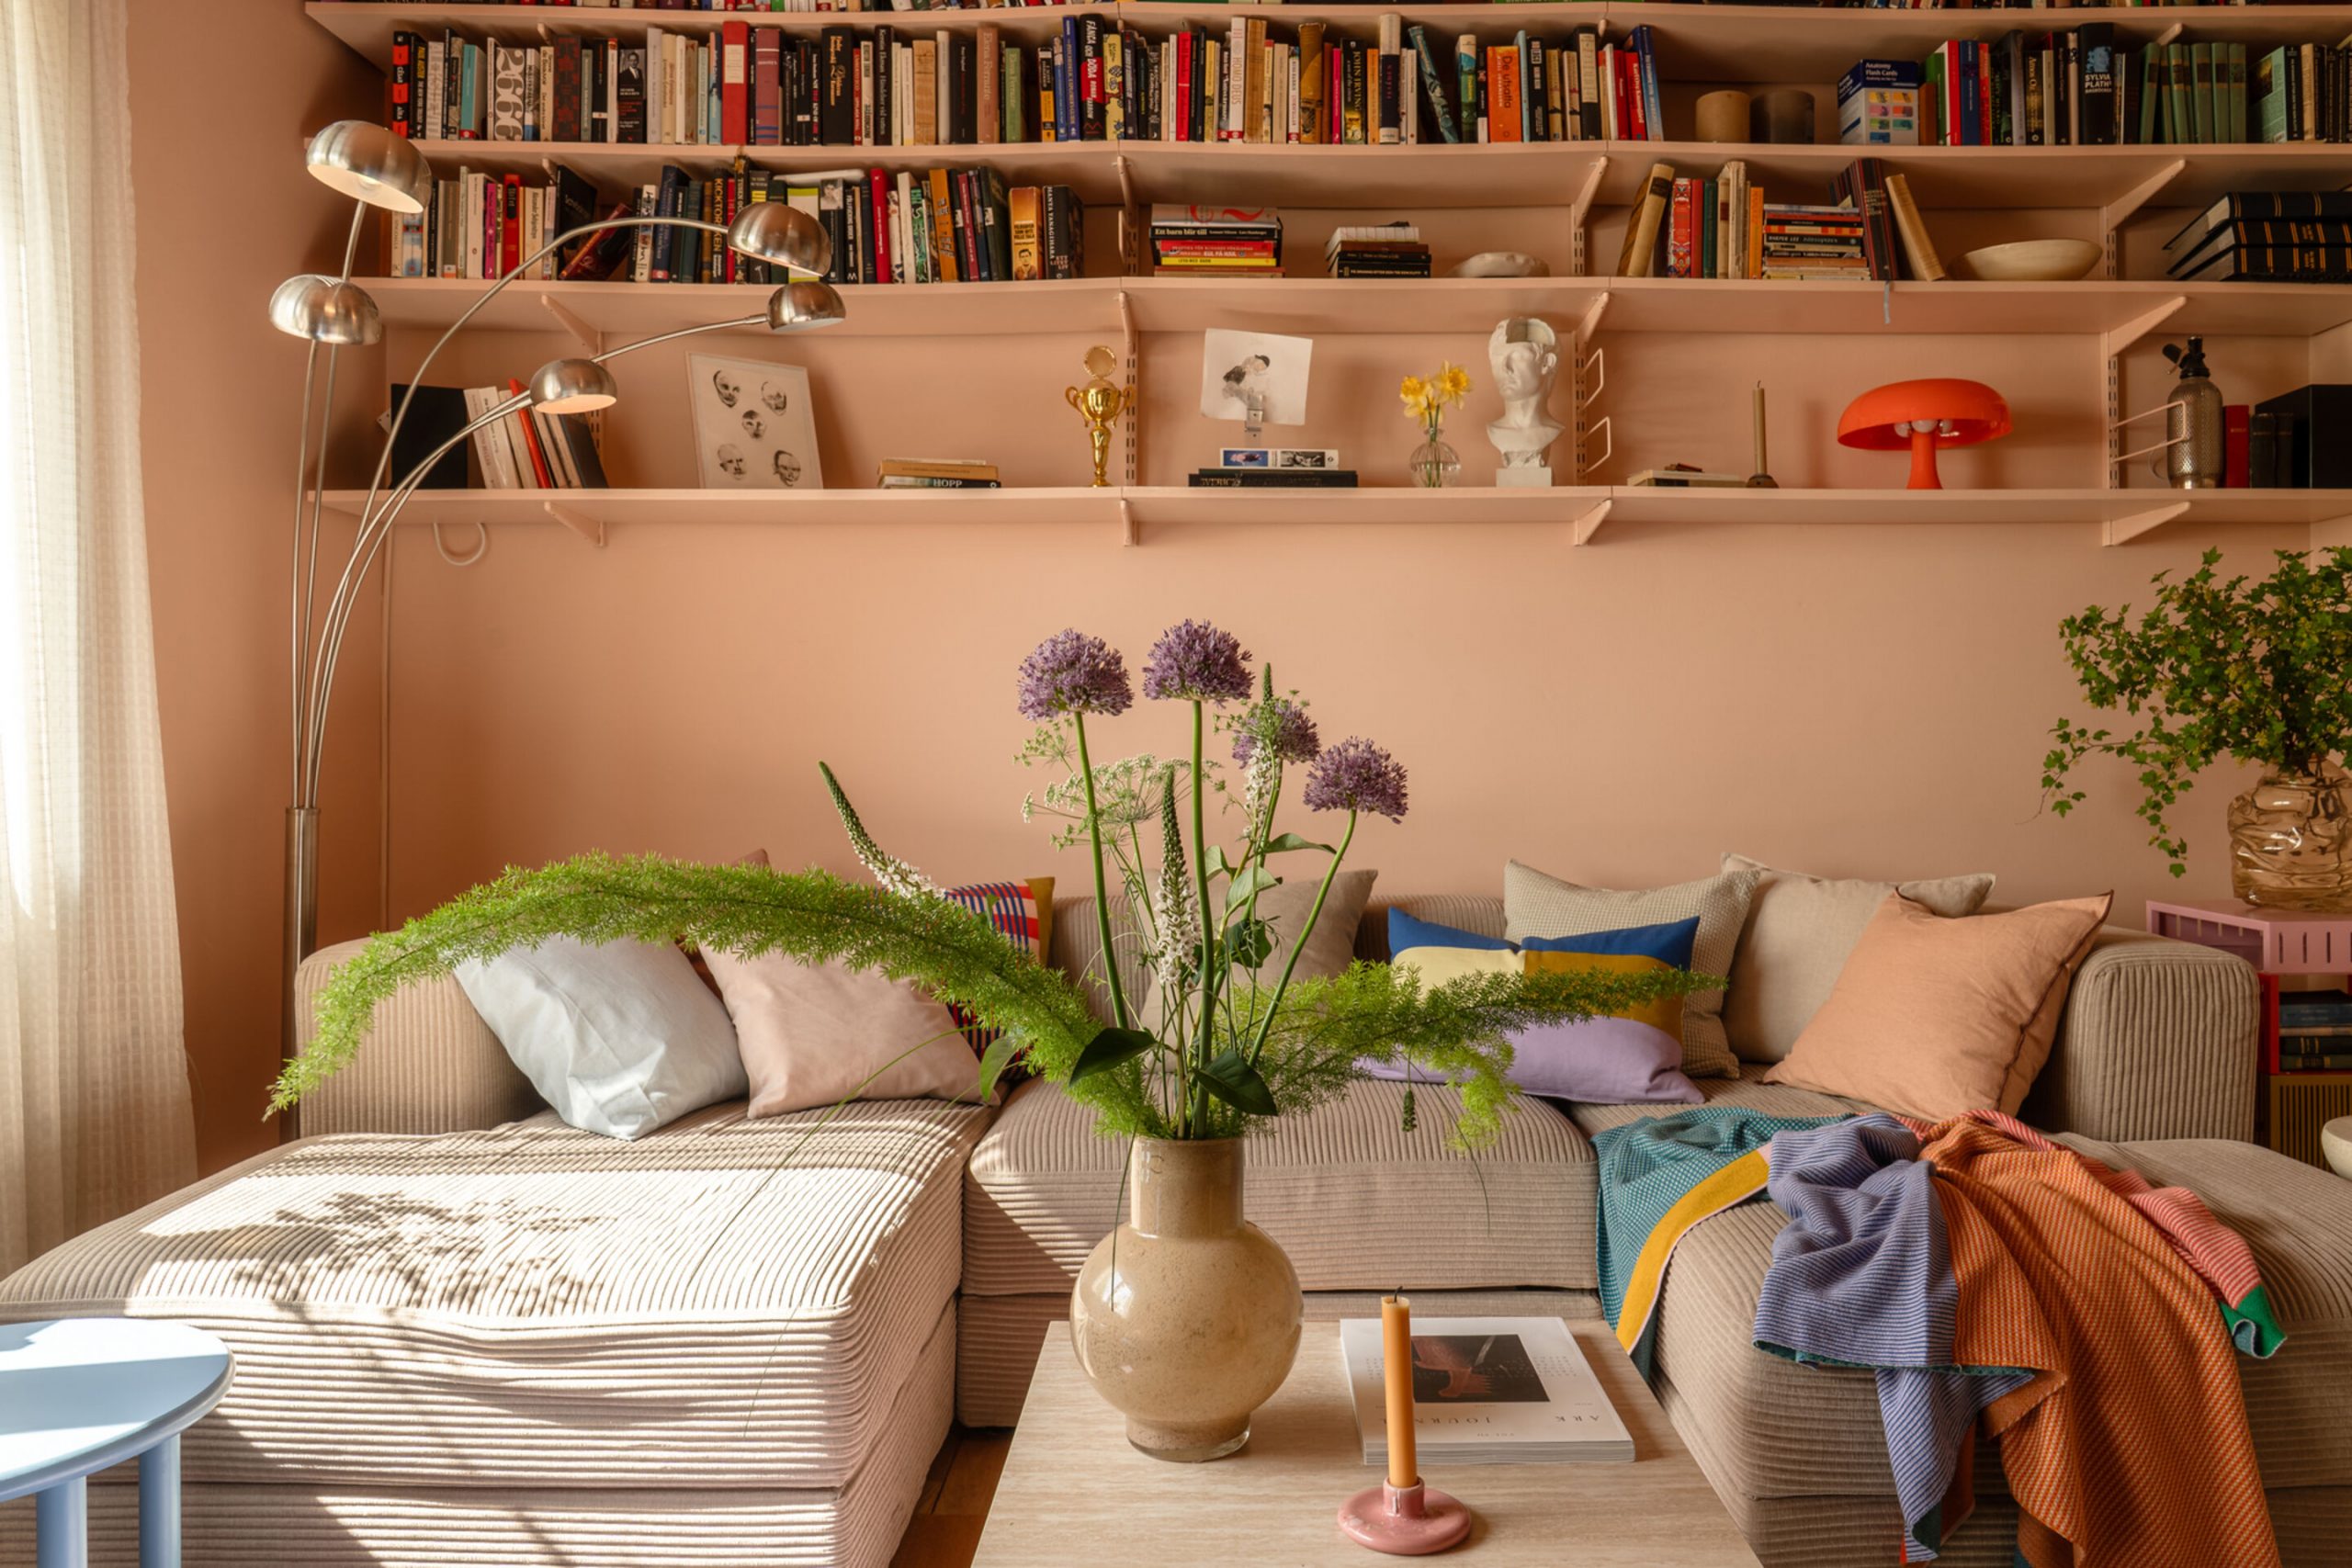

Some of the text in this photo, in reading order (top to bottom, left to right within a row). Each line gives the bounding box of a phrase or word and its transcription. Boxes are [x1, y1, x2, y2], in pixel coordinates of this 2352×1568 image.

[1085, 20, 1097, 45] FÅNGA
[983, 32, 993, 100] Elena Ferrante
[1084, 45, 1093, 58] OCH
[1087, 58, 1097, 79] DÖDA
[1353, 51, 1362, 76] JOHN
[495, 47, 525, 141] 2666
[1232, 57, 1243, 105] HOMO DEUS
[1501, 56, 1513, 108] De utsatta
[713, 178, 723, 252] KICKTORKEN
[933, 479, 963, 488] HOPP
